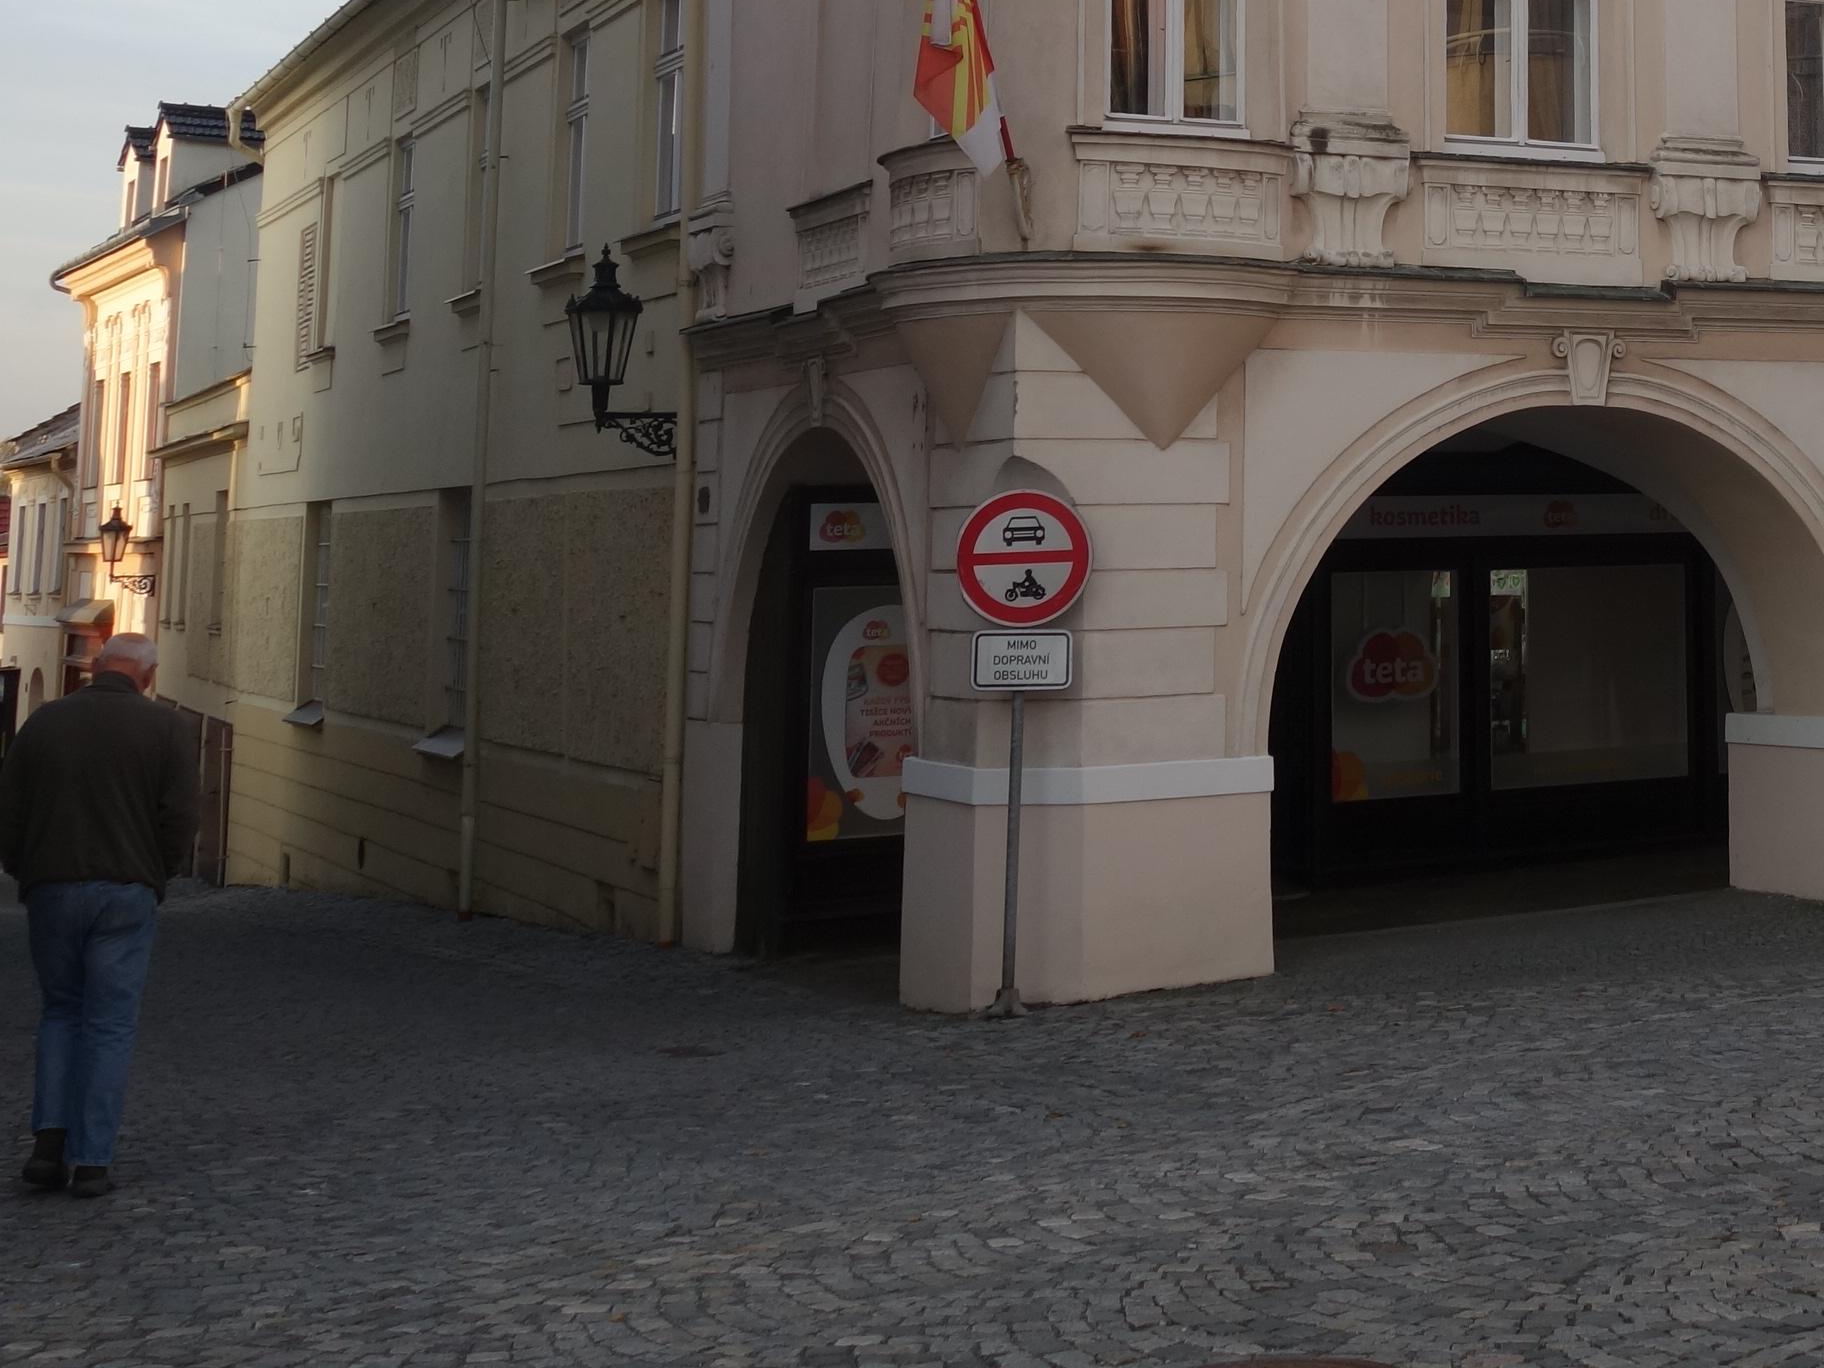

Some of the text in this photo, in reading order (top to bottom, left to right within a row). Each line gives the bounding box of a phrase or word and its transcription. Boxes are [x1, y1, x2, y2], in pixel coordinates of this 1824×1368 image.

[1368, 504, 1481, 526] kosmetika
[826, 522, 862, 537] teta
[1007, 640, 1037, 651] MIMO
[993, 652, 1050, 666] DOPRAVNÍ
[993, 670, 1048, 681] OBSLUHU
[1363, 657, 1425, 685] teta
